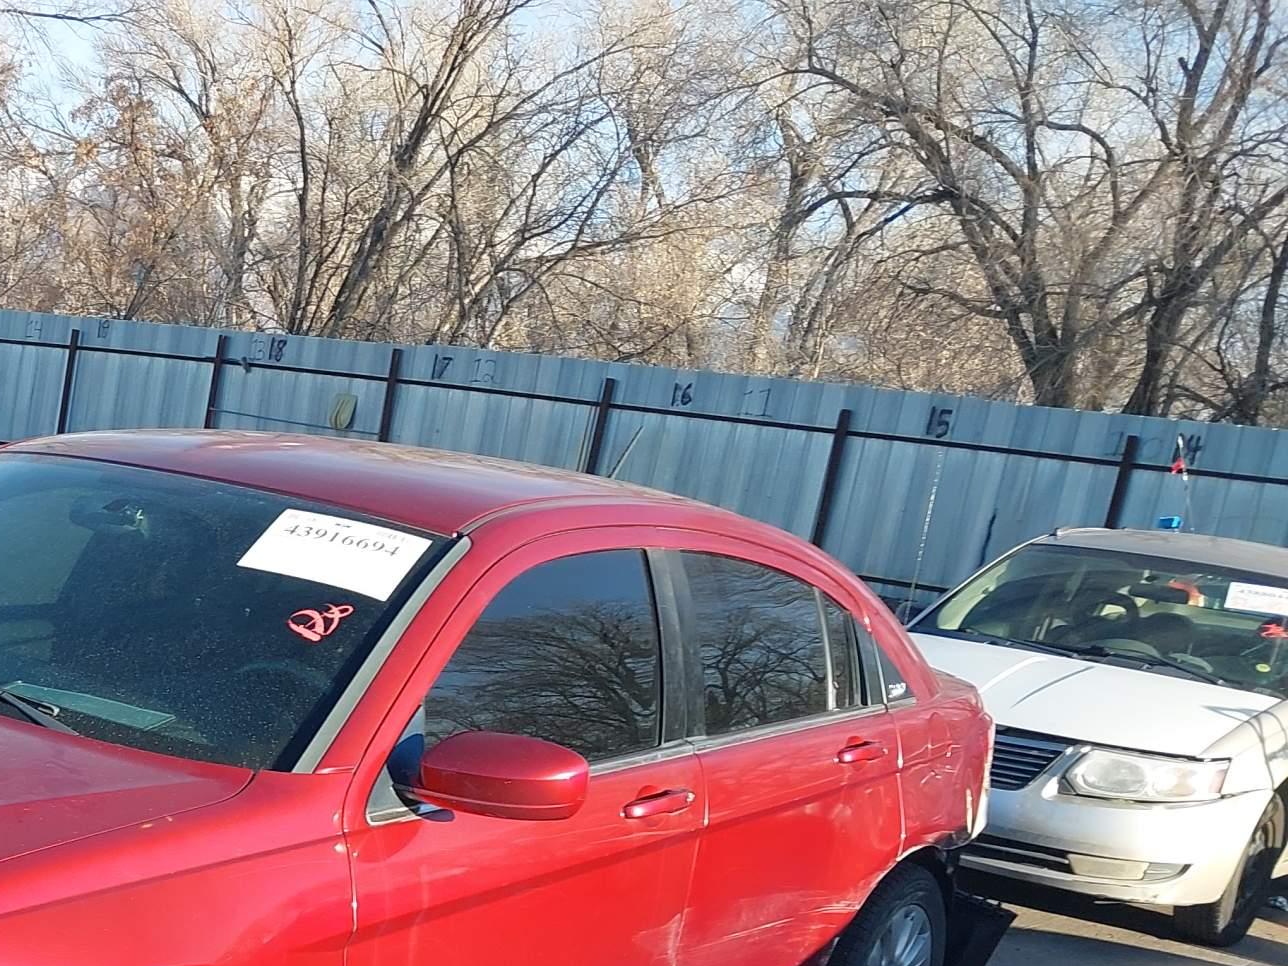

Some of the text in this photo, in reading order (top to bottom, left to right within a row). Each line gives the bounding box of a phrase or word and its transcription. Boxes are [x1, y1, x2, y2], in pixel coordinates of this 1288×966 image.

[268, 336, 288, 362] 18
[430, 353, 454, 381] 17
[670, 382, 694, 407] 16
[925, 405, 954, 439] 15
[283, 524, 401, 557] 43916694
